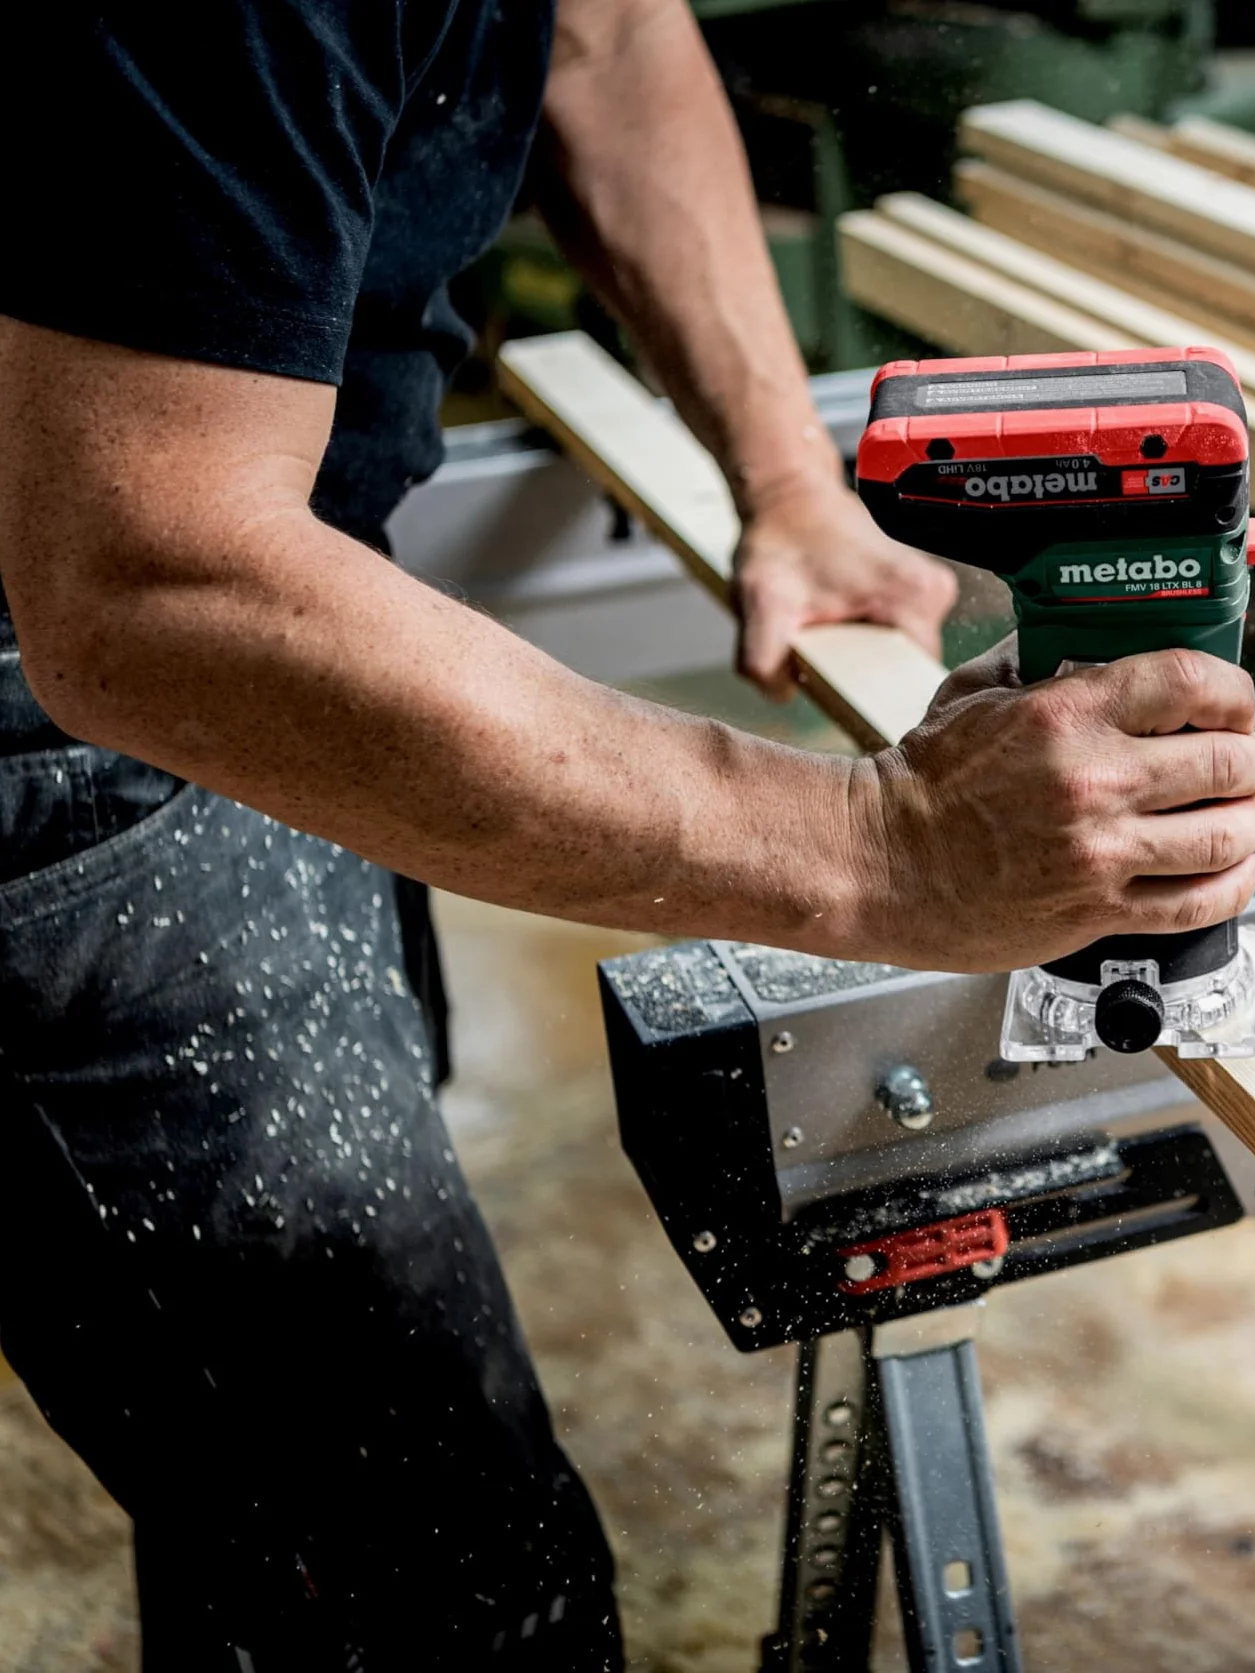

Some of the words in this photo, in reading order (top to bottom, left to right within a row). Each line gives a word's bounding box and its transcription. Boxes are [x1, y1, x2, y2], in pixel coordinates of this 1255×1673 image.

[966, 463, 988, 473] 18V
[964, 471, 1098, 502] metabo
[1059, 554, 1201, 584] metabo
[1125, 583, 1146, 592] FMV
[1149, 583, 1160, 591] 18
[1162, 581, 1179, 590] LTX
[1182, 581, 1194, 589] BL
[1195, 580, 1202, 588] 8
